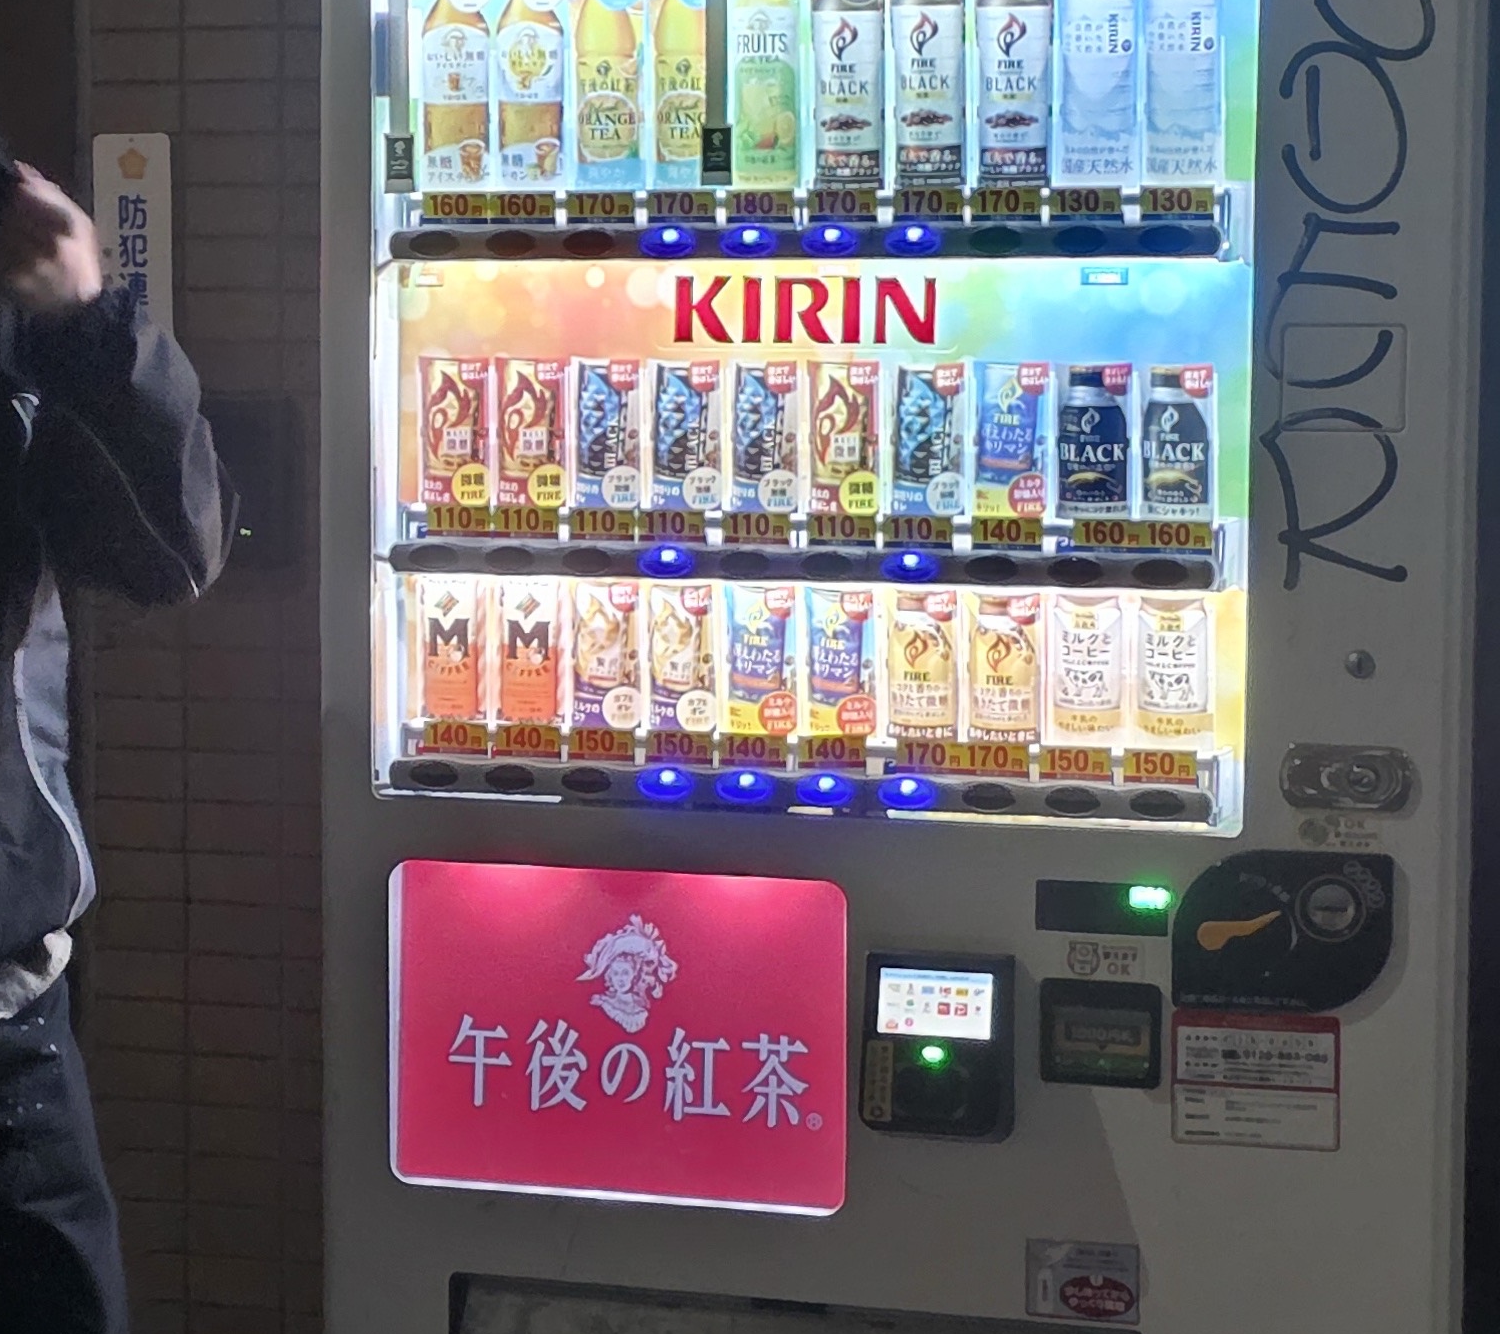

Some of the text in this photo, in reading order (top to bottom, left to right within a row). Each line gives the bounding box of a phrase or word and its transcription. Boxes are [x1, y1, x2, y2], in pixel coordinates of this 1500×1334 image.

[1190, 11, 1202, 52] KIRIN
[737, 33, 788, 54] FRUITS
[820, 80, 868, 95] BLACK
[901, 75, 950, 90] BLACK
[986, 76, 1037, 91] BLACK
[588, 127, 621, 141] TEA
[674, 275, 936, 344] KIRIN
[993, 413, 1020, 425] FIRE
[1060, 443, 1124, 463] BLACK
[1143, 440, 1205, 461] BLACK
[461, 489, 484, 499] FIRE
[537, 491, 561, 500] FIRE
[849, 498, 874, 508] FIRE
[428, 617, 470, 659] M
[506, 619, 550, 661] M
[1062, 631, 1112, 645] ミルクと
[1146, 633, 1196, 647] ミルクと
[1062, 645, 1110, 657] コーヒー
[1145, 649, 1196, 660] コーヒー
[904, 671, 931, 682] FIRE
[986, 675, 1014, 686] FIRE
[448, 1013, 810, 1128] 午後の紅茶
